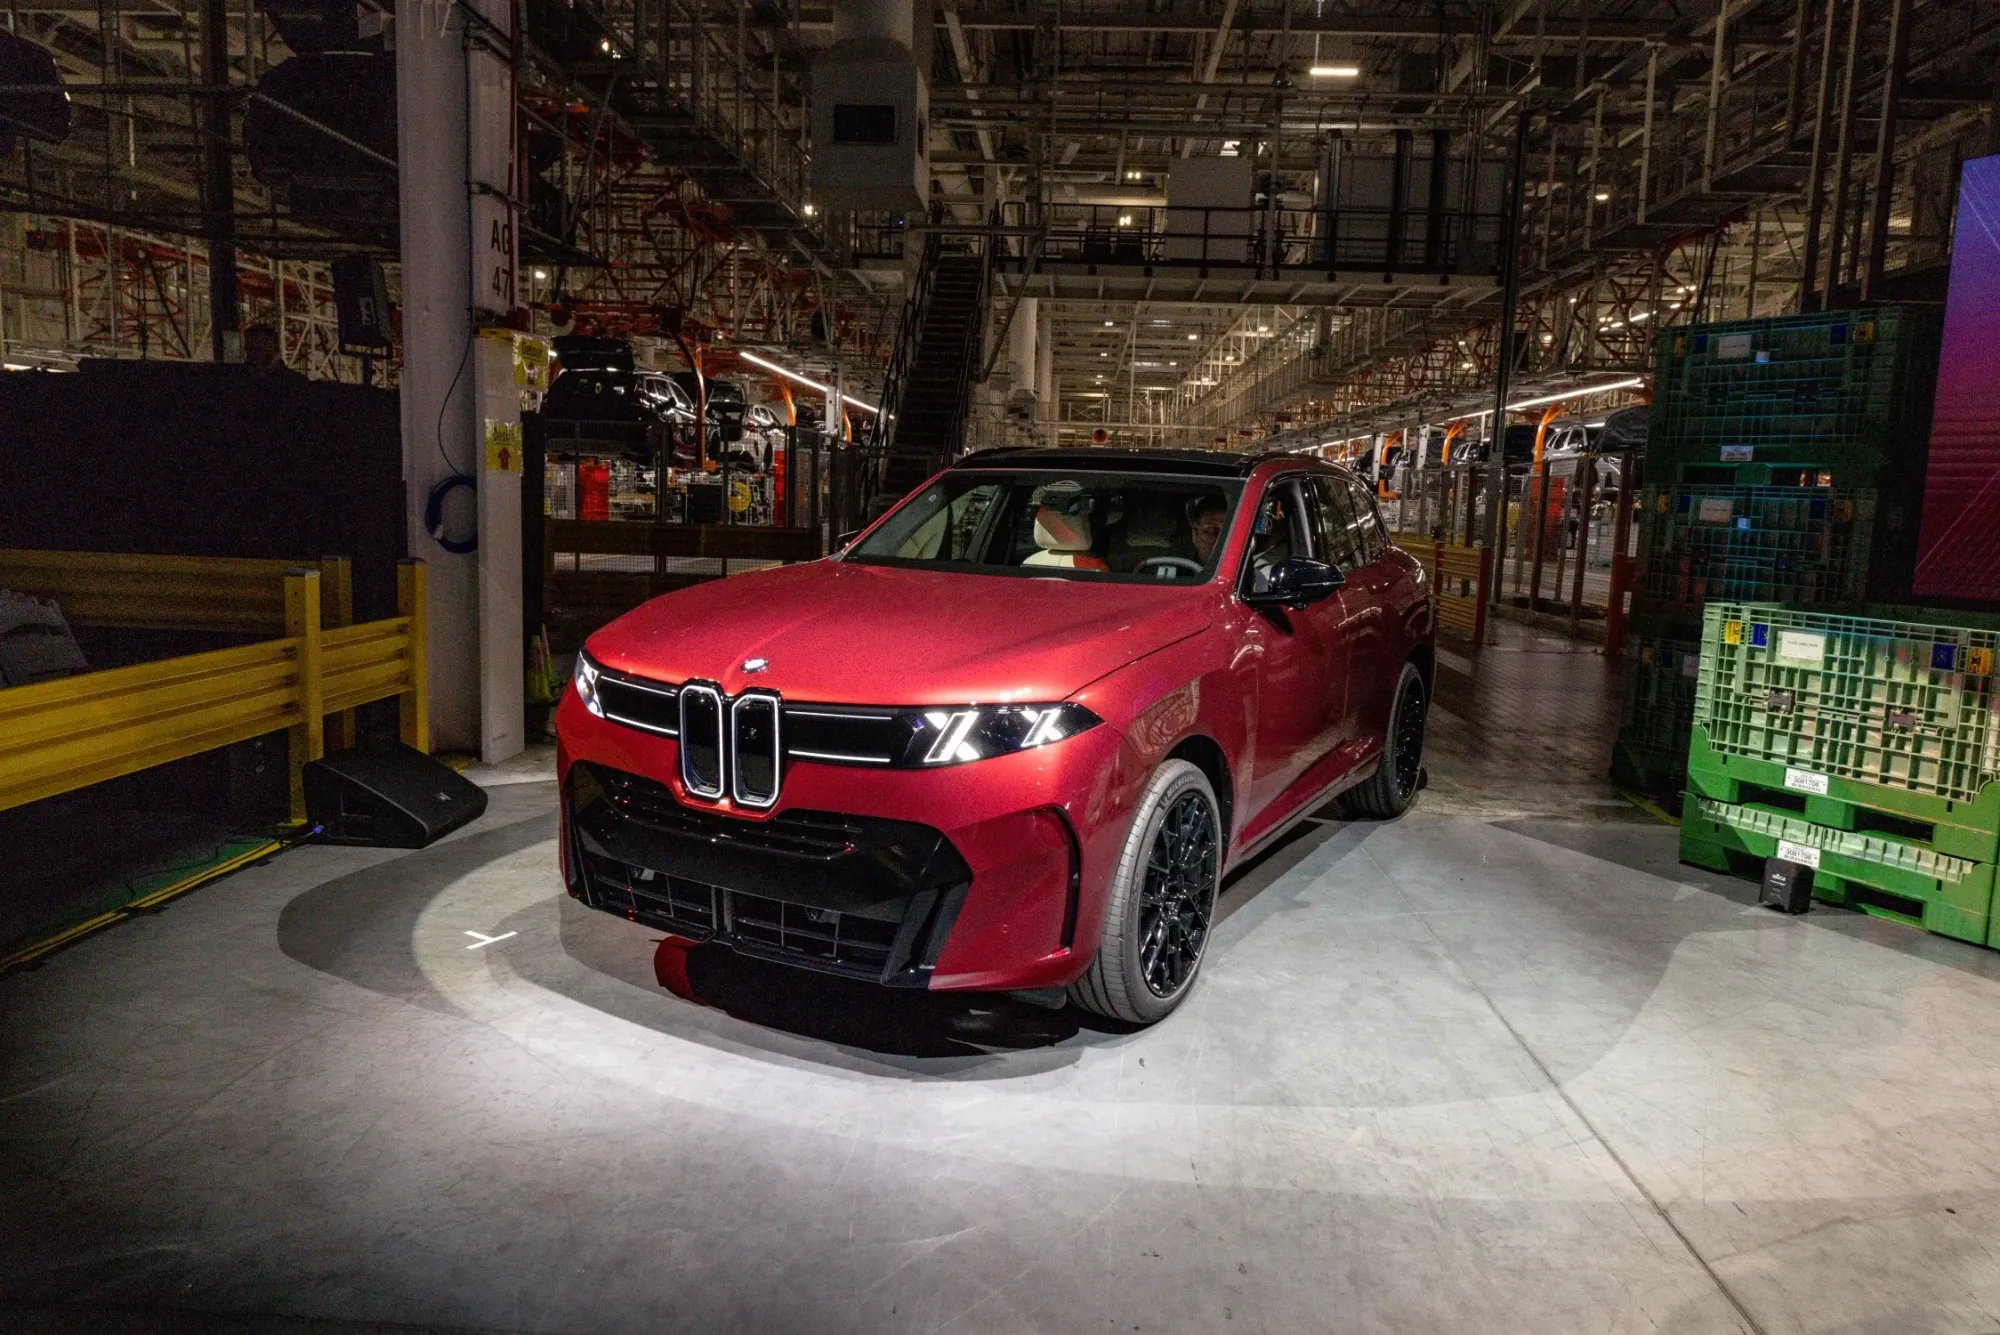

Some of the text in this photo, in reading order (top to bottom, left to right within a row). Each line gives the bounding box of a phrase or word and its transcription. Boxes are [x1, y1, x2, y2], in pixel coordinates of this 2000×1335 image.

[492, 266, 510, 300] 47
[521, 340, 543, 359] Detour
[1166, 774, 1195, 798] MICHELIN
